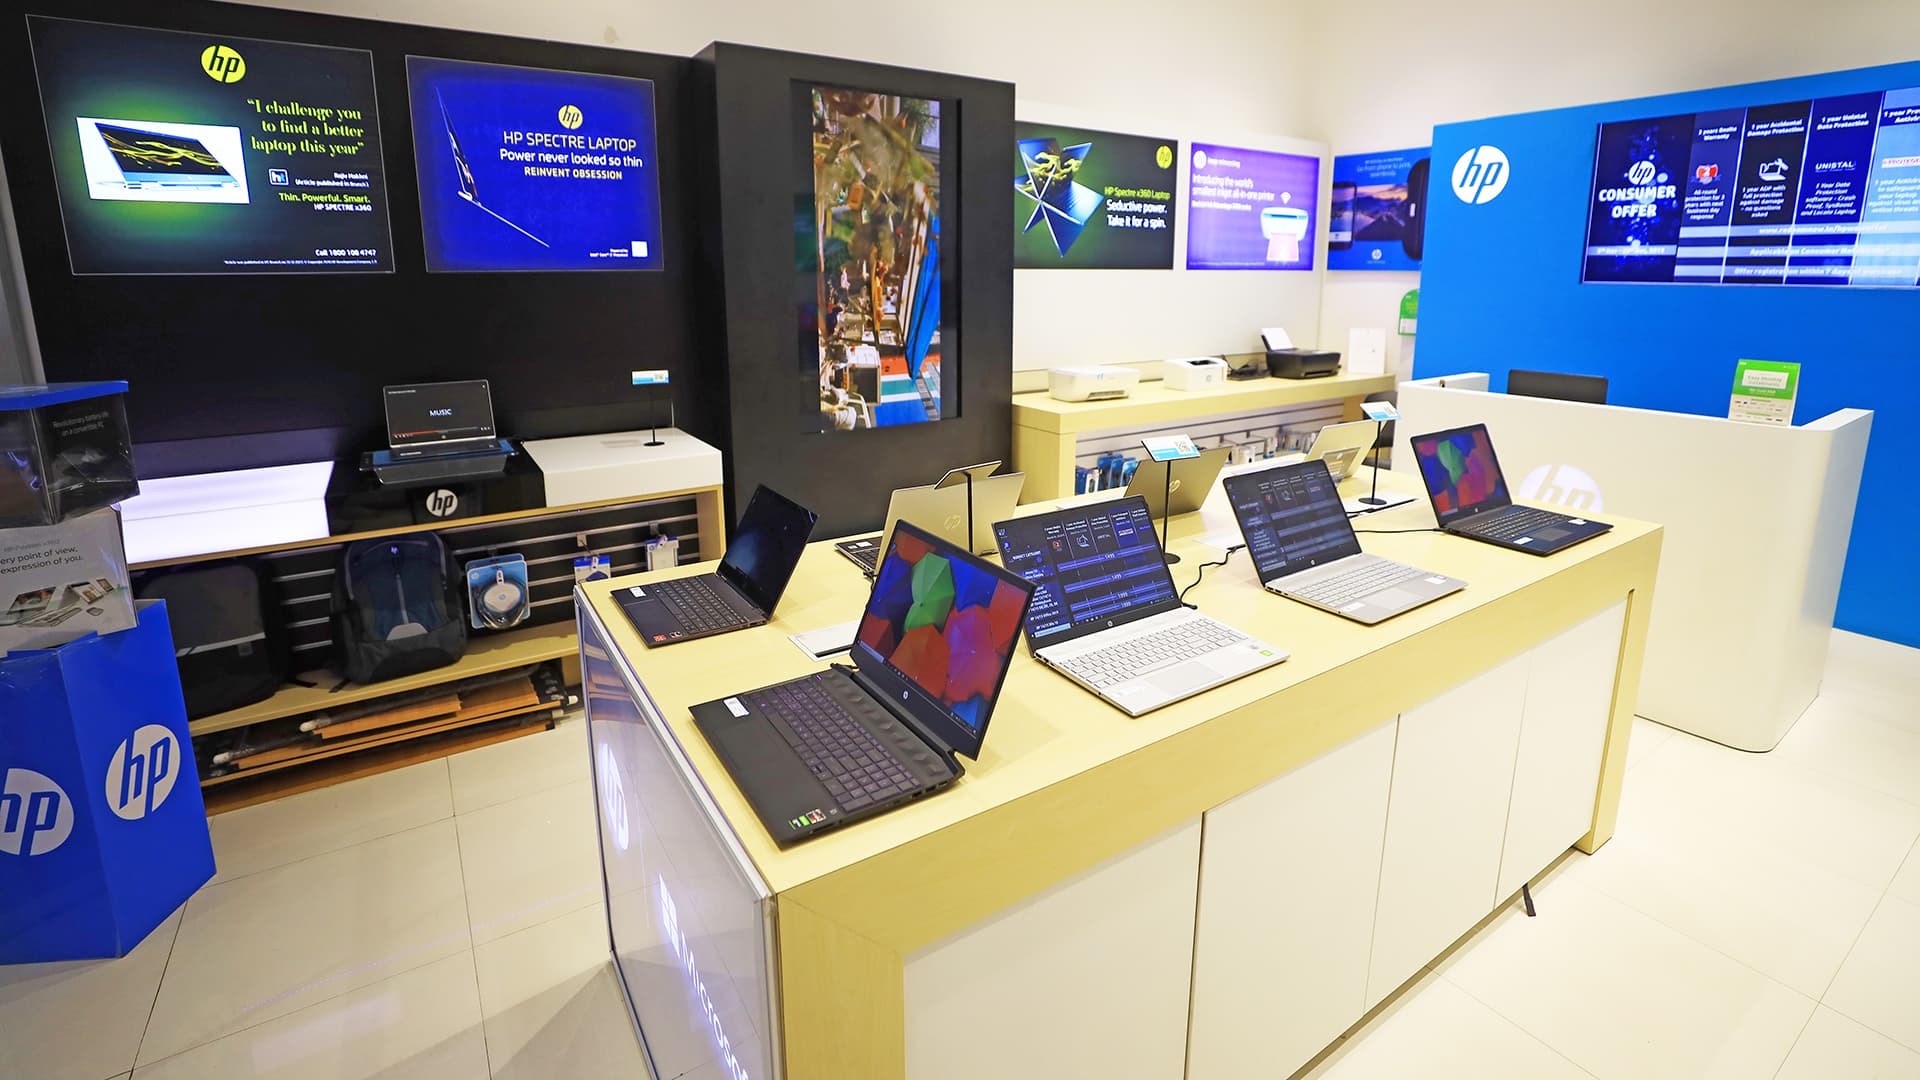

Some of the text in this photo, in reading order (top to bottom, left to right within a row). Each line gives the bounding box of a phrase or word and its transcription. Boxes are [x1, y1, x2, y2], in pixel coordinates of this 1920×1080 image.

[205, 44, 242, 83] hp
[265, 100, 333, 121] challenge
[337, 108, 362, 122] you
[561, 105, 582, 129] hp
[1889, 110, 1905, 118] year
[1756, 123, 1770, 131] year
[1770, 119, 1803, 128] Accidental
[1827, 116, 1842, 124] year
[1834, 120, 1869, 129] Protection
[261, 120, 364, 138] to find a better
[1772, 126, 1804, 135] Protection
[251, 136, 296, 156] laptop
[300, 139, 326, 153] this
[503, 131, 637, 151] HP SPECTRE LAPTOP
[500, 148, 642, 167] Power never looked so thin
[524, 166, 622, 180] REINVENT OBSESSION
[1630, 160, 1654, 185] hp
[1816, 161, 1854, 170] UNISTAL
[1457, 145, 1505, 205] hp
[278, 192, 371, 203] Thin. Powerful. Smart.
[1104, 186, 1114, 195] HP
[1114, 187, 1136, 197] Spectre
[1598, 185, 1676, 202] CONSUMER
[325, 204, 354, 212] SPECTRE
[1106, 199, 1168, 214] Seductive power.
[1612, 204, 1657, 218] OFFER
[1107, 215, 1166, 230] Take it for a spin.
[430, 408, 452, 417] MUSIC
[430, 489, 456, 517] hp
[18, 552, 42, 562] point
[44, 549, 53, 557] of
[55, 547, 78, 555] view.
[0, 560, 52, 574] expression
[53, 557, 62, 565] of
[119, 727, 171, 818] hp
